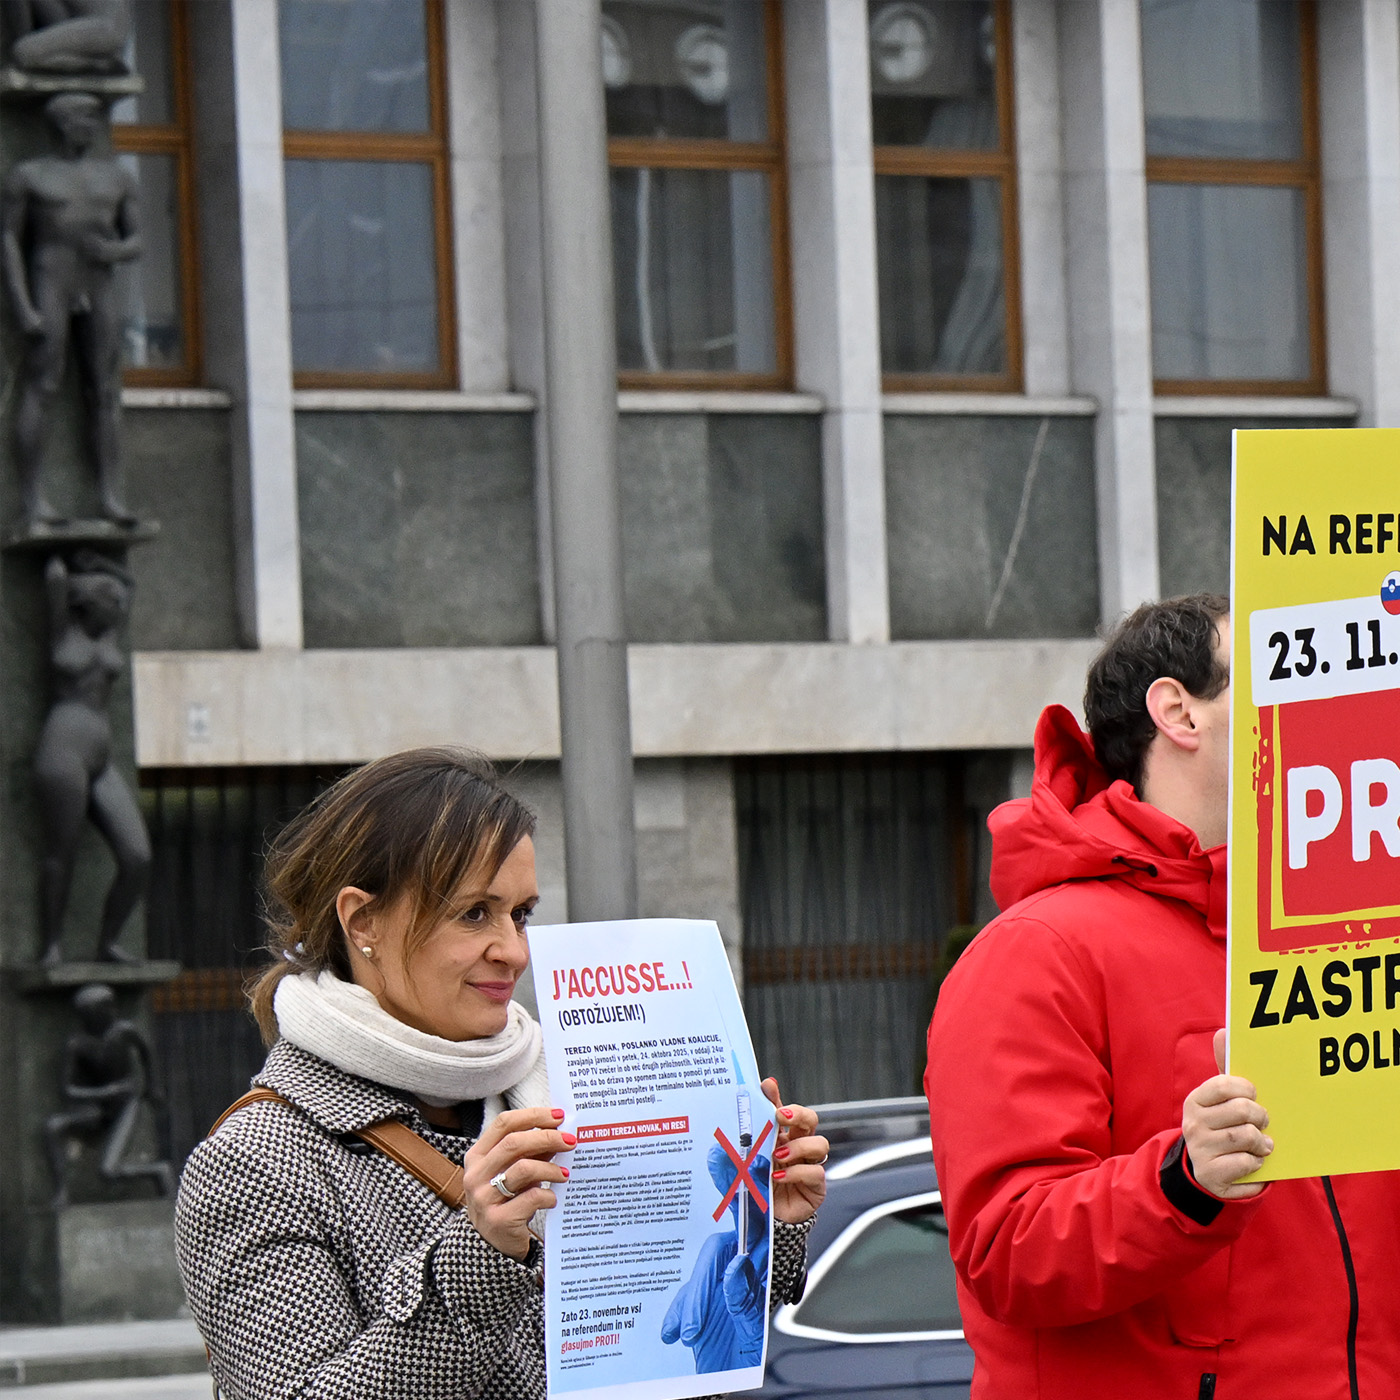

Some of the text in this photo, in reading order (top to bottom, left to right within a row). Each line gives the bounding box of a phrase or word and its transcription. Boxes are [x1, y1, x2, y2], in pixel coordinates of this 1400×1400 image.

[1262, 514, 1316, 556] NA
[1268, 628, 1331, 681] 23.
[1346, 620, 1399, 671] 11.
[553, 961, 693, 1000] J'ACCUSSE...!
[558, 1003, 646, 1031] (OBTOŽUJEM!)
[579, 1120, 686, 1139] KAR TRDI TEREZA NOVAK, NI RES!
[561, 1303, 642, 1323] Zato 23. novembra vsi
[562, 1318, 634, 1337] na referendum in vsi
[561, 1334, 620, 1354] glasujmo PROTI!
